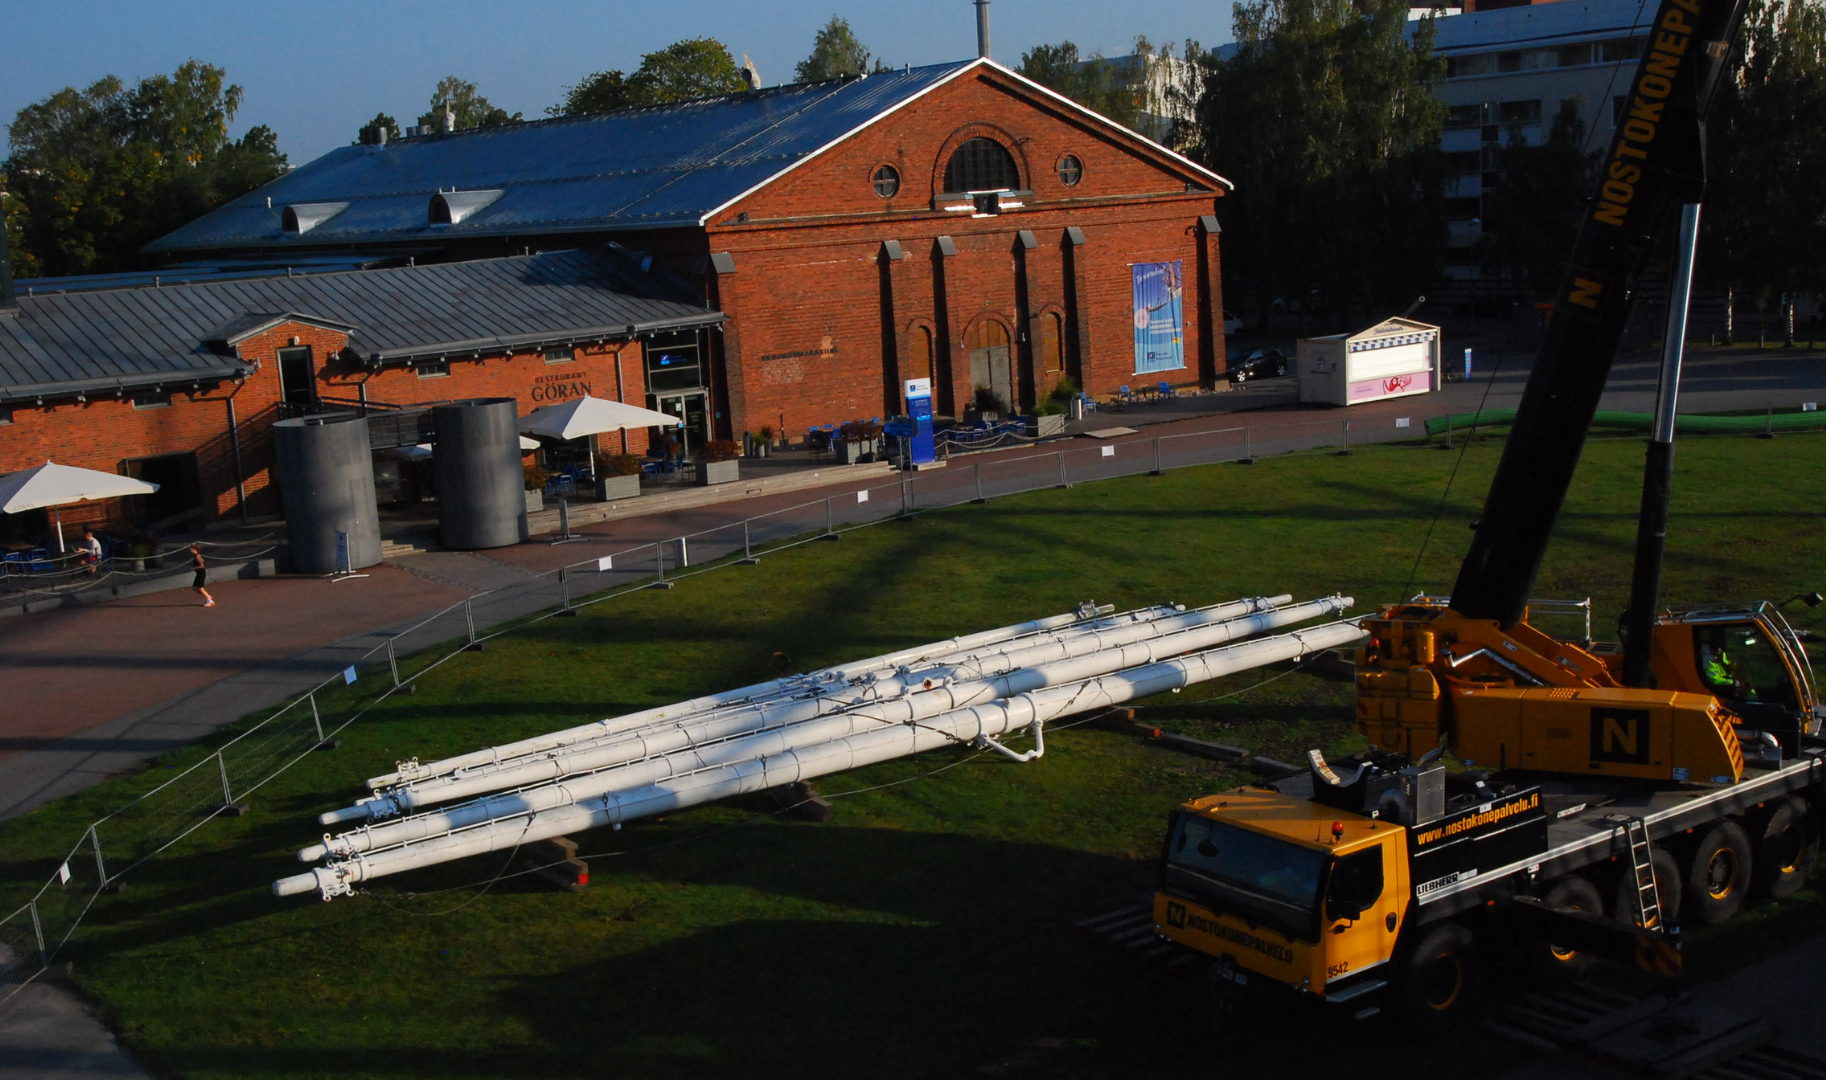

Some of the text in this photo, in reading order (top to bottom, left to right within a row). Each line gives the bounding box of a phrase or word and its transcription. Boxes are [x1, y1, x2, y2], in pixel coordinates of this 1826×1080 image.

[1568, 277, 1601, 309] N
[531, 380, 592, 402] GÖRAN
[1602, 717, 1638, 755] N
[1417, 793, 1539, 846] www.nostokonepalvelu.fi
[1417, 873, 1460, 895] LIEBHERR
[1187, 913, 1294, 964] NOSTOKONEPALVELU
[1327, 961, 1349, 979] 9542
